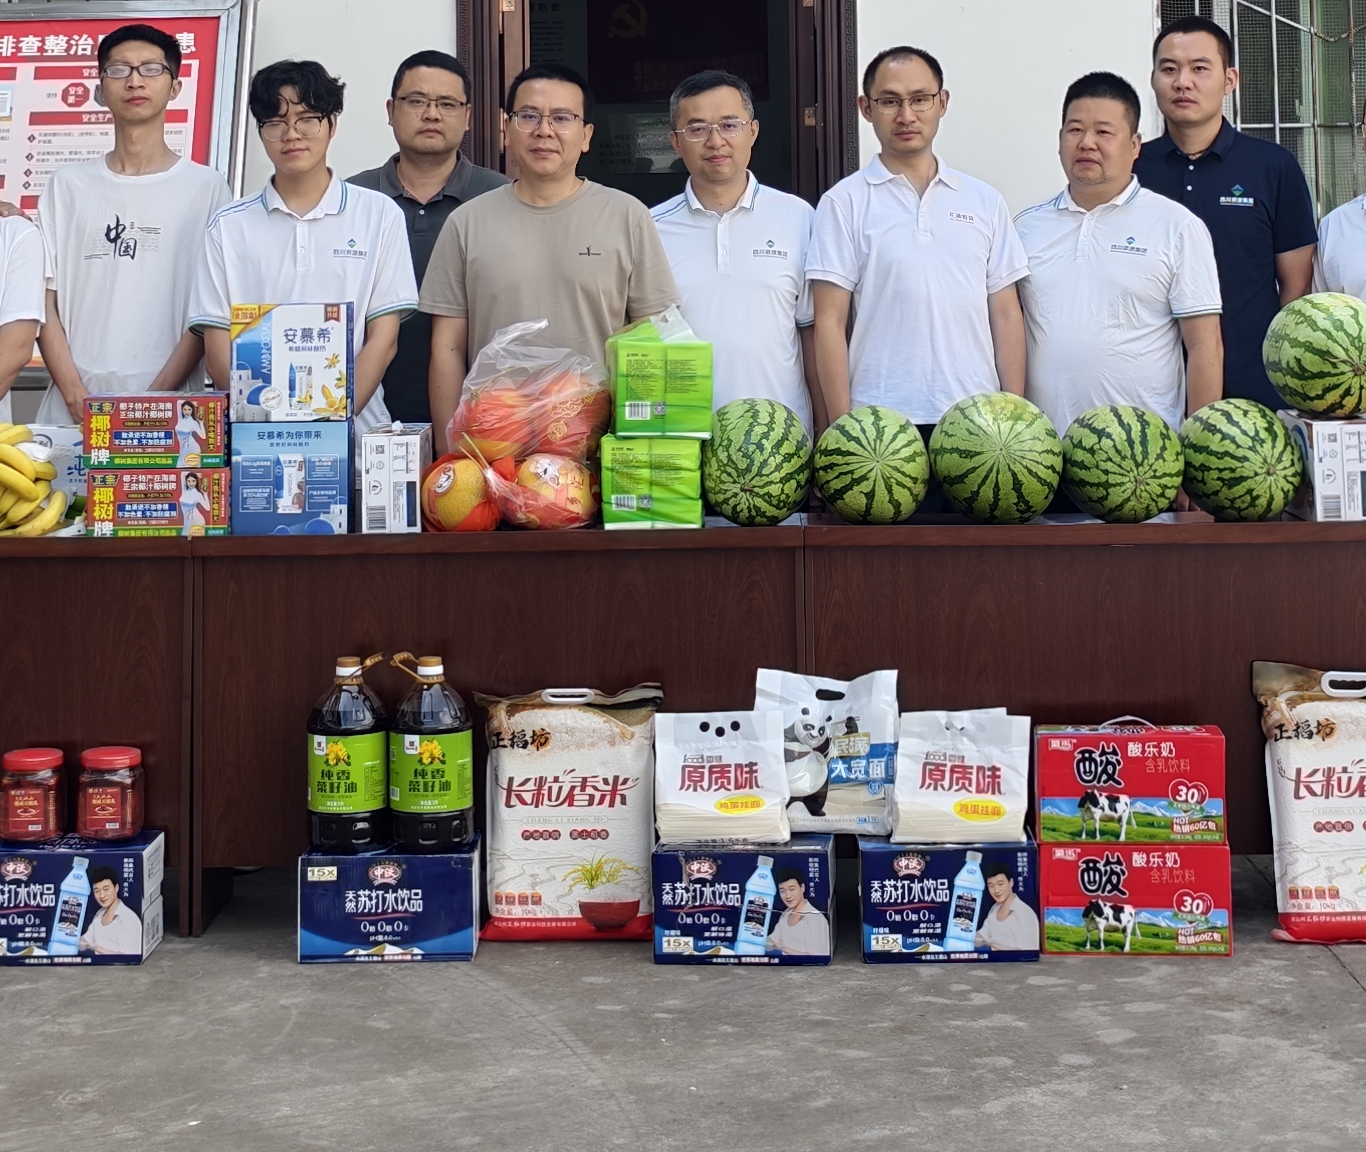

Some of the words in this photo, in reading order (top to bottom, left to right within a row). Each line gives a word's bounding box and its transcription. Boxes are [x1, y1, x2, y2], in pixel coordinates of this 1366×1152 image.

[68, 86, 85, 95] 安全
[67, 95, 84, 104] 第一
[283, 327, 332, 344] 安慕希
[90, 415, 111, 465] 椰树牌
[1127, 741, 1176, 757] 酸乐奶
[830, 758, 886, 779] 大宽面
[1145, 757, 1190, 773] 含乳饮料
[320, 768, 351, 781] 纯香
[413, 768, 446, 780] 纯香
[678, 761, 761, 792] 原质味
[919, 761, 1003, 795] 原质味
[316, 781, 357, 794] 菜籽油
[408, 779, 452, 793] 菜籽油
[504, 773, 628, 808] 长粒香米
[1175, 785, 1199, 804] 30
[1132, 851, 1181, 867] 酸乐奶
[1150, 868, 1195, 884] 含乳饮料
[661, 882, 741, 906] 天然苏打水饮品
[870, 879, 950, 903] 天然苏打水饮品
[345, 888, 423, 913] 天然苏打水饮品
[1180, 896, 1204, 914] 30
